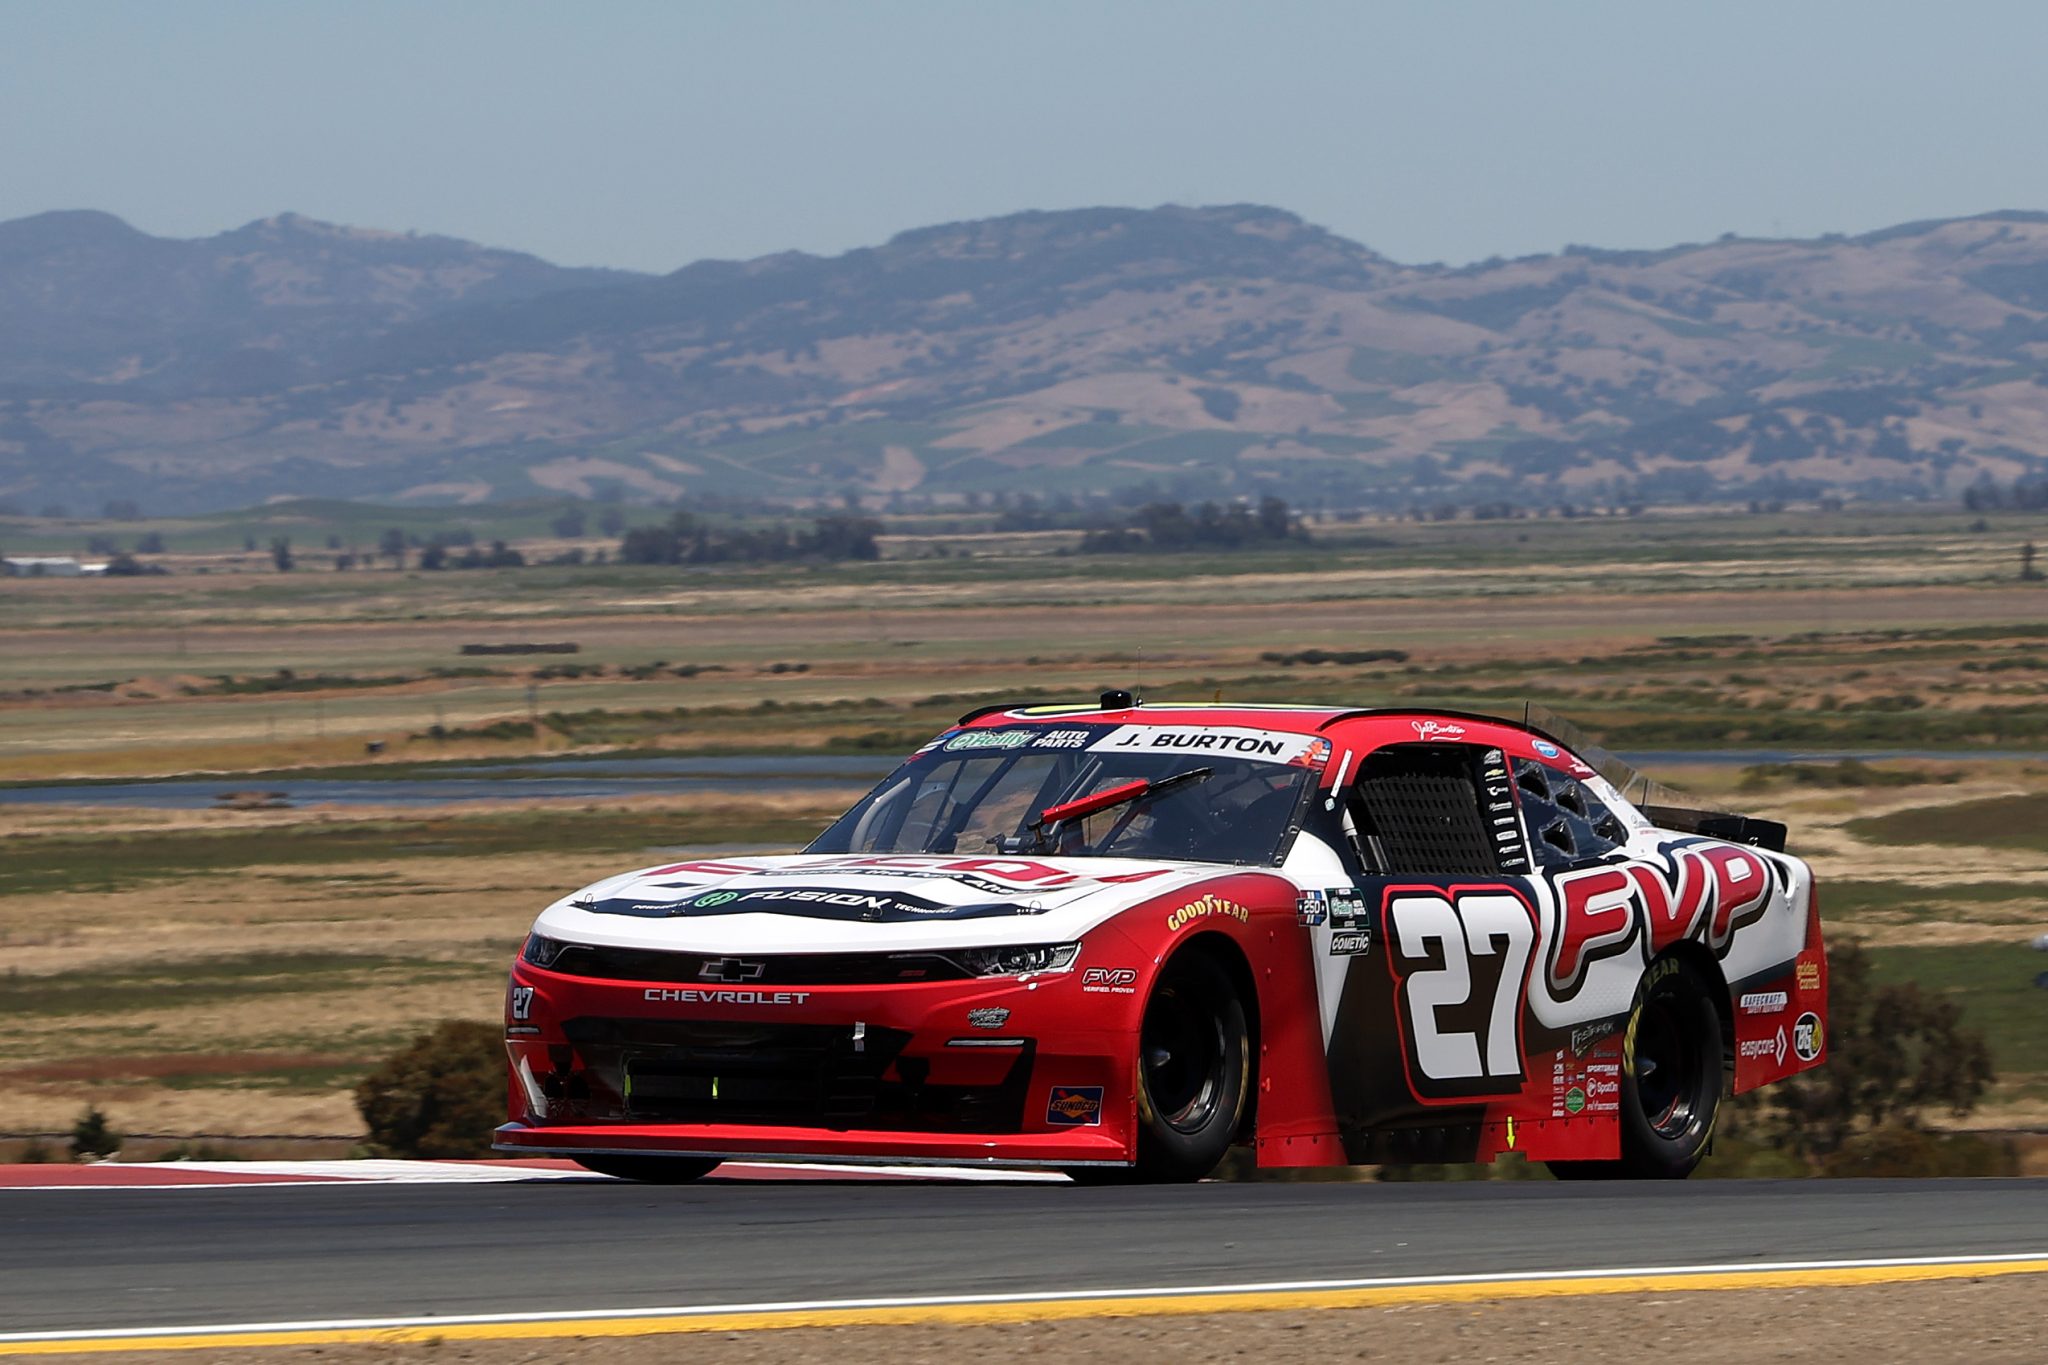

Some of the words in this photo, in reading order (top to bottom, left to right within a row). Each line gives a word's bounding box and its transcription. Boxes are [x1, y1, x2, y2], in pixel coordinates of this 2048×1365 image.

[1031, 738, 1086, 748] PARTS
[1045, 730, 1090, 739] AUTO
[1116, 733, 1140, 746] J.
[1151, 733, 1285, 756] BURTON
[737, 891, 892, 909] FUSION
[1303, 901, 1321, 914] 250
[1167, 894, 1249, 932] GOODYEAR
[1550, 843, 1771, 990] FVP
[1332, 934, 1369, 951] COMETIC
[1082, 968, 1136, 985] FVP
[643, 988, 810, 1005] CHEVROLET
[1391, 895, 1536, 1081] 27
[512, 986, 535, 1020] 27
[1743, 994, 1782, 1006] SAFECRAFT
[1050, 1100, 1099, 1112] SUNOCO
